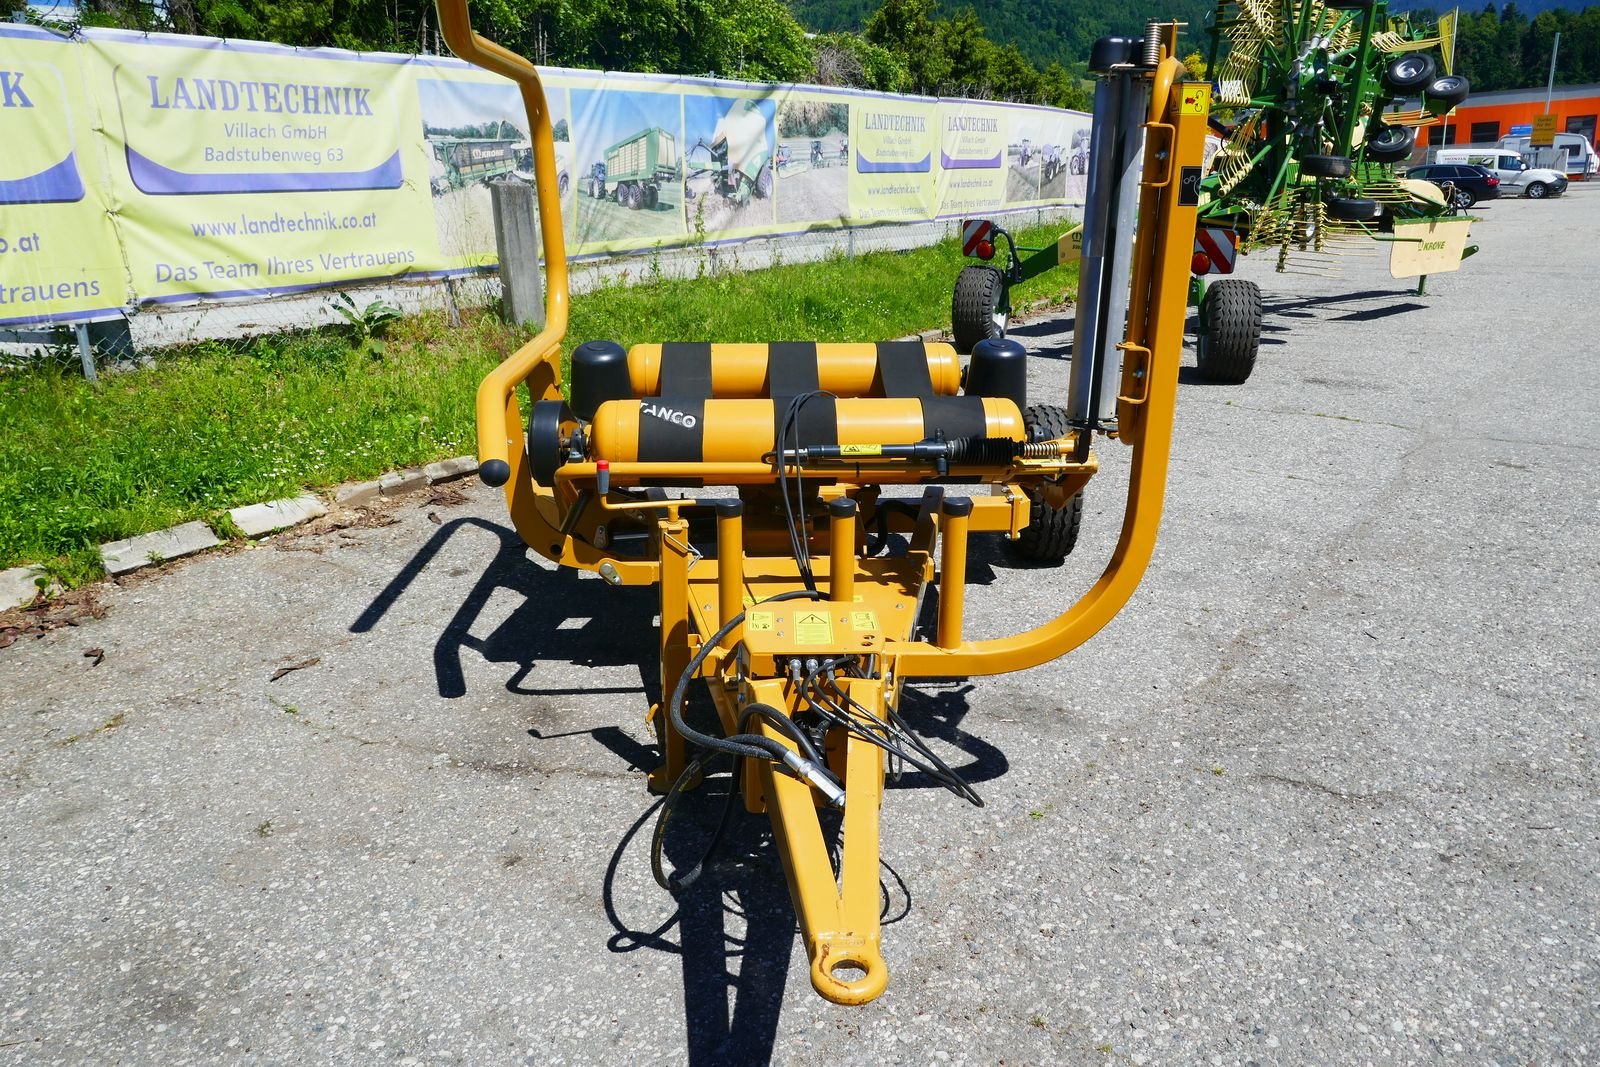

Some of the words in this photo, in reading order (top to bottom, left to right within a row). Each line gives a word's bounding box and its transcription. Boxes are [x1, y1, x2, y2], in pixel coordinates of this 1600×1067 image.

[147, 75, 374, 116] LANDTECHNIK
[224, 122, 276, 139] Villach
[282, 124, 327, 140] GmbH
[865, 112, 926, 132] LANDTECHNIK
[205, 146, 322, 165] Badstubenweg
[327, 147, 344, 162] 63
[191, 211, 376, 237] www.landtechnik.co.at
[1423, 241, 1446, 250] KRONE
[156, 264, 198, 283] Das
[203, 260, 259, 279] Team
[267, 256, 314, 275] Ihres
[319, 249, 415, 271] Vertrauens
